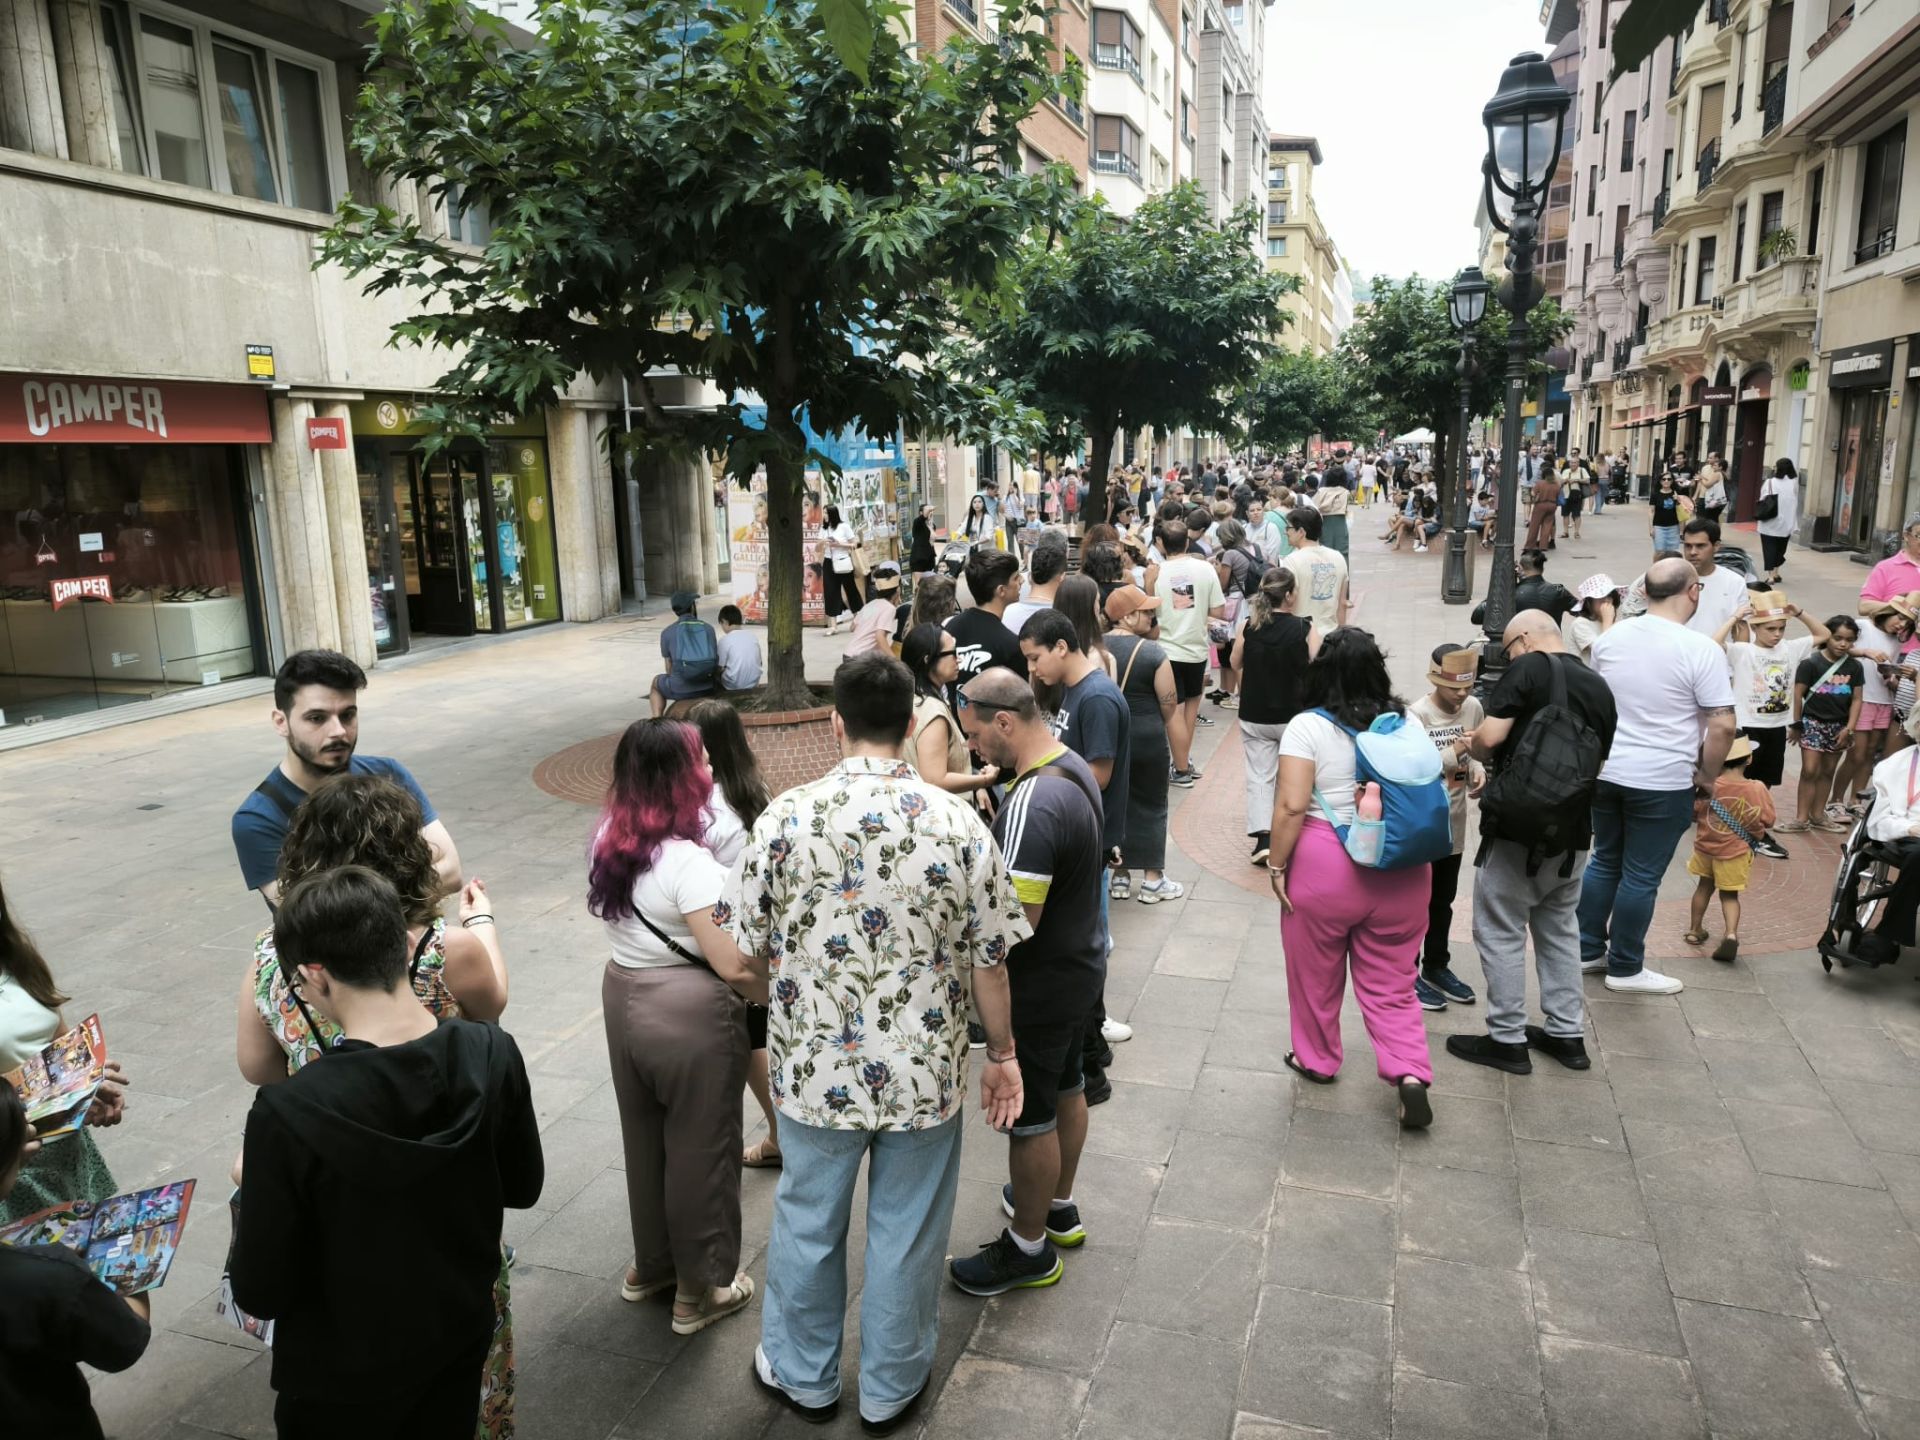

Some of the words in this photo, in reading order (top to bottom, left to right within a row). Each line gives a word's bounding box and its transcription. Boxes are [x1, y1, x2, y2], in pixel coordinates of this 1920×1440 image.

[22, 380, 168, 438] CAMPER
[310, 426, 338, 439] CAMPER
[54, 578, 110, 602] CAMPER
